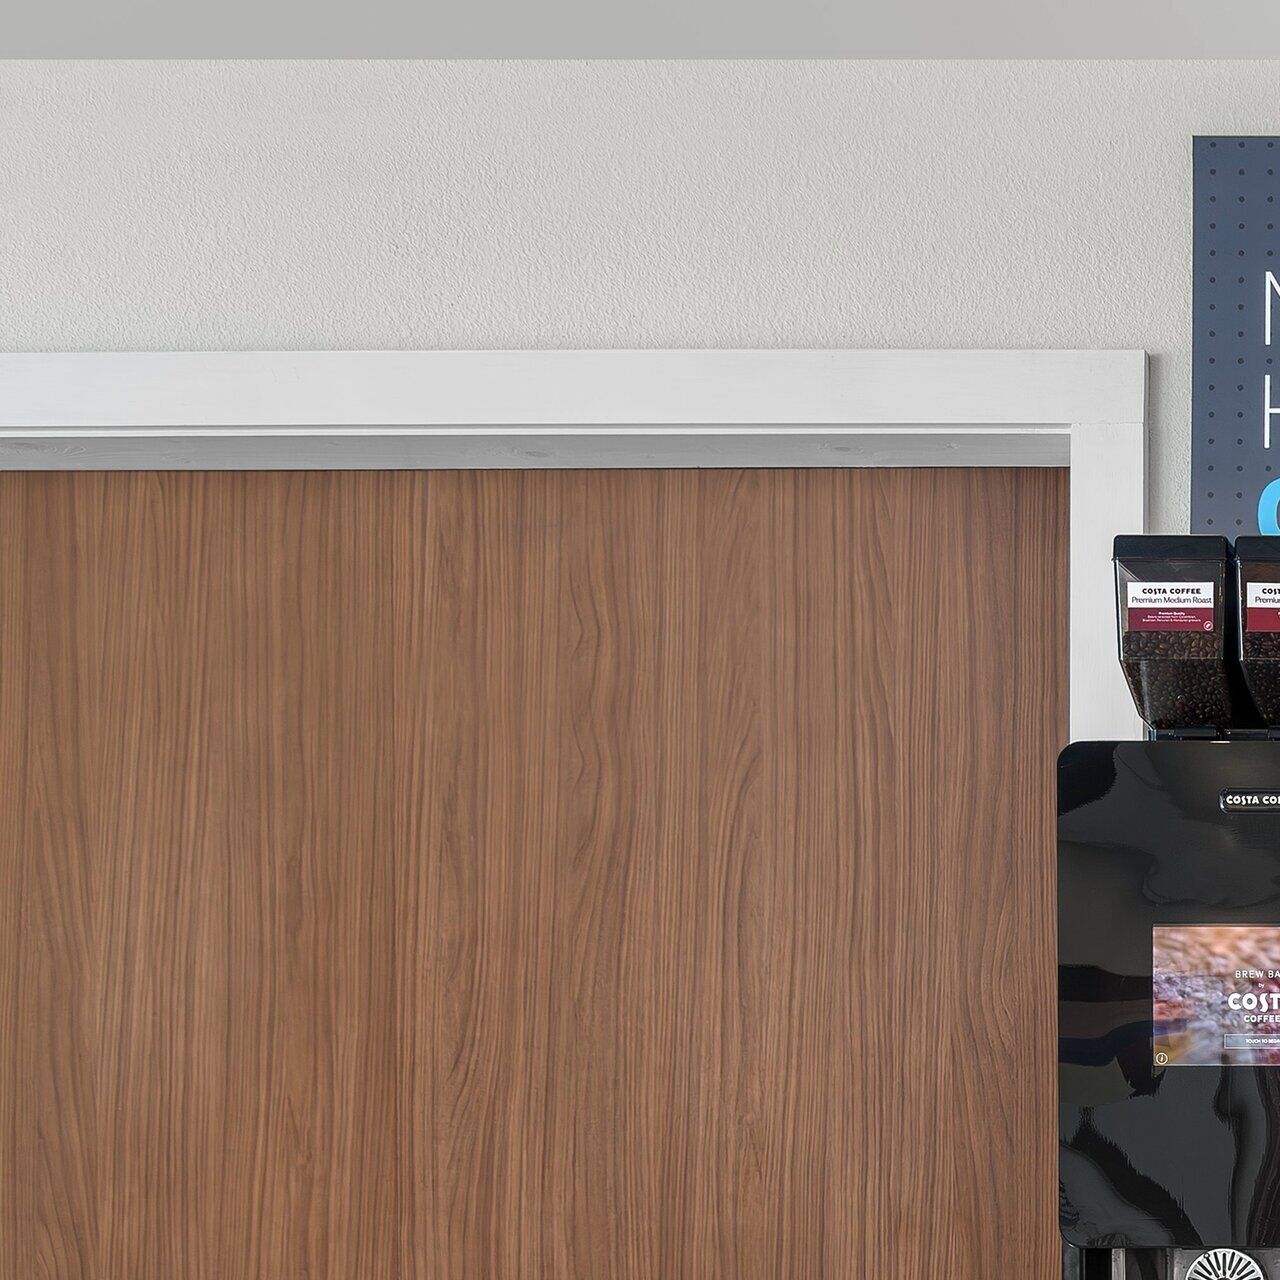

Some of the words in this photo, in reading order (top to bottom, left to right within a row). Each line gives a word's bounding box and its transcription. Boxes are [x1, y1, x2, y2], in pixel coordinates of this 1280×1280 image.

[1132, 596, 1162, 604] Premium
[1164, 596, 1191, 604] Medium
[1226, 795, 1259, 806] COSTA
[1235, 970, 1264, 978] BREW
[1243, 1015, 1280, 1023] COFFEE
